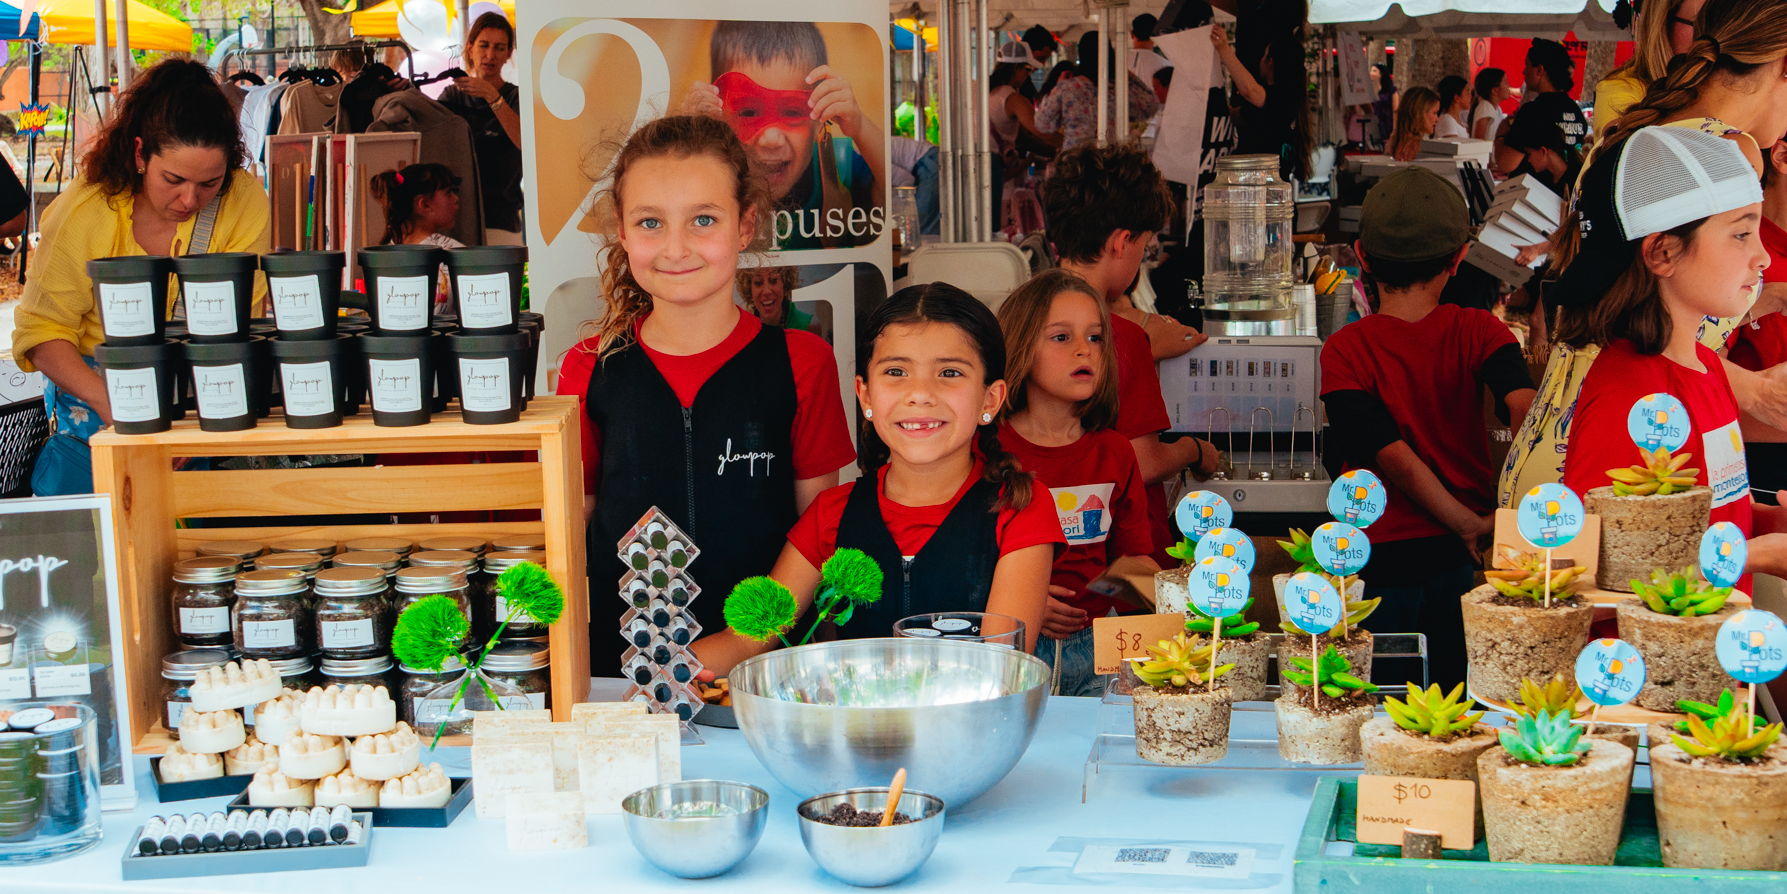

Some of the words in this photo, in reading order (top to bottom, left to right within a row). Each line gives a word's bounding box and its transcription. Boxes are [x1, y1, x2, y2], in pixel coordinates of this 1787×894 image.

[767, 205, 888, 251] puses
[717, 437, 776, 478] glowpop
[1060, 515, 1079, 525] asa
[1062, 525, 1080, 535] ori
[0, 554, 69, 610] pop
[1115, 627, 1142, 659] $8
[1097, 665, 1120, 673] HANDM
[1392, 782, 1432, 805] $10
